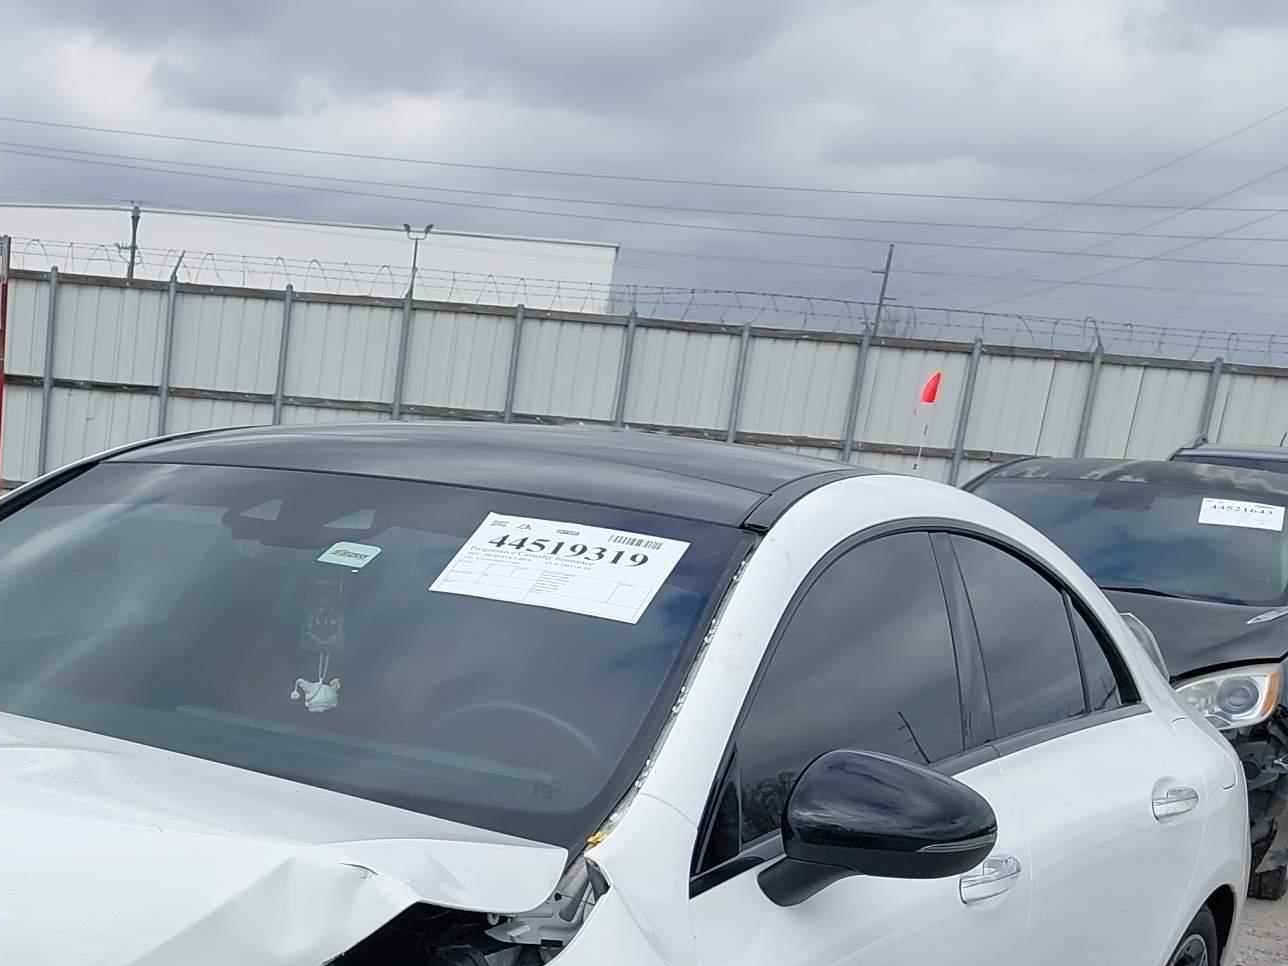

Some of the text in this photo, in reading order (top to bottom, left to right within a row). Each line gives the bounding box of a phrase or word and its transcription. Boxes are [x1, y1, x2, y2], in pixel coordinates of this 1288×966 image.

[470, 545, 516, 556] Progressive
[518, 550, 552, 561] Casualty
[488, 534, 649, 567] 44519319
